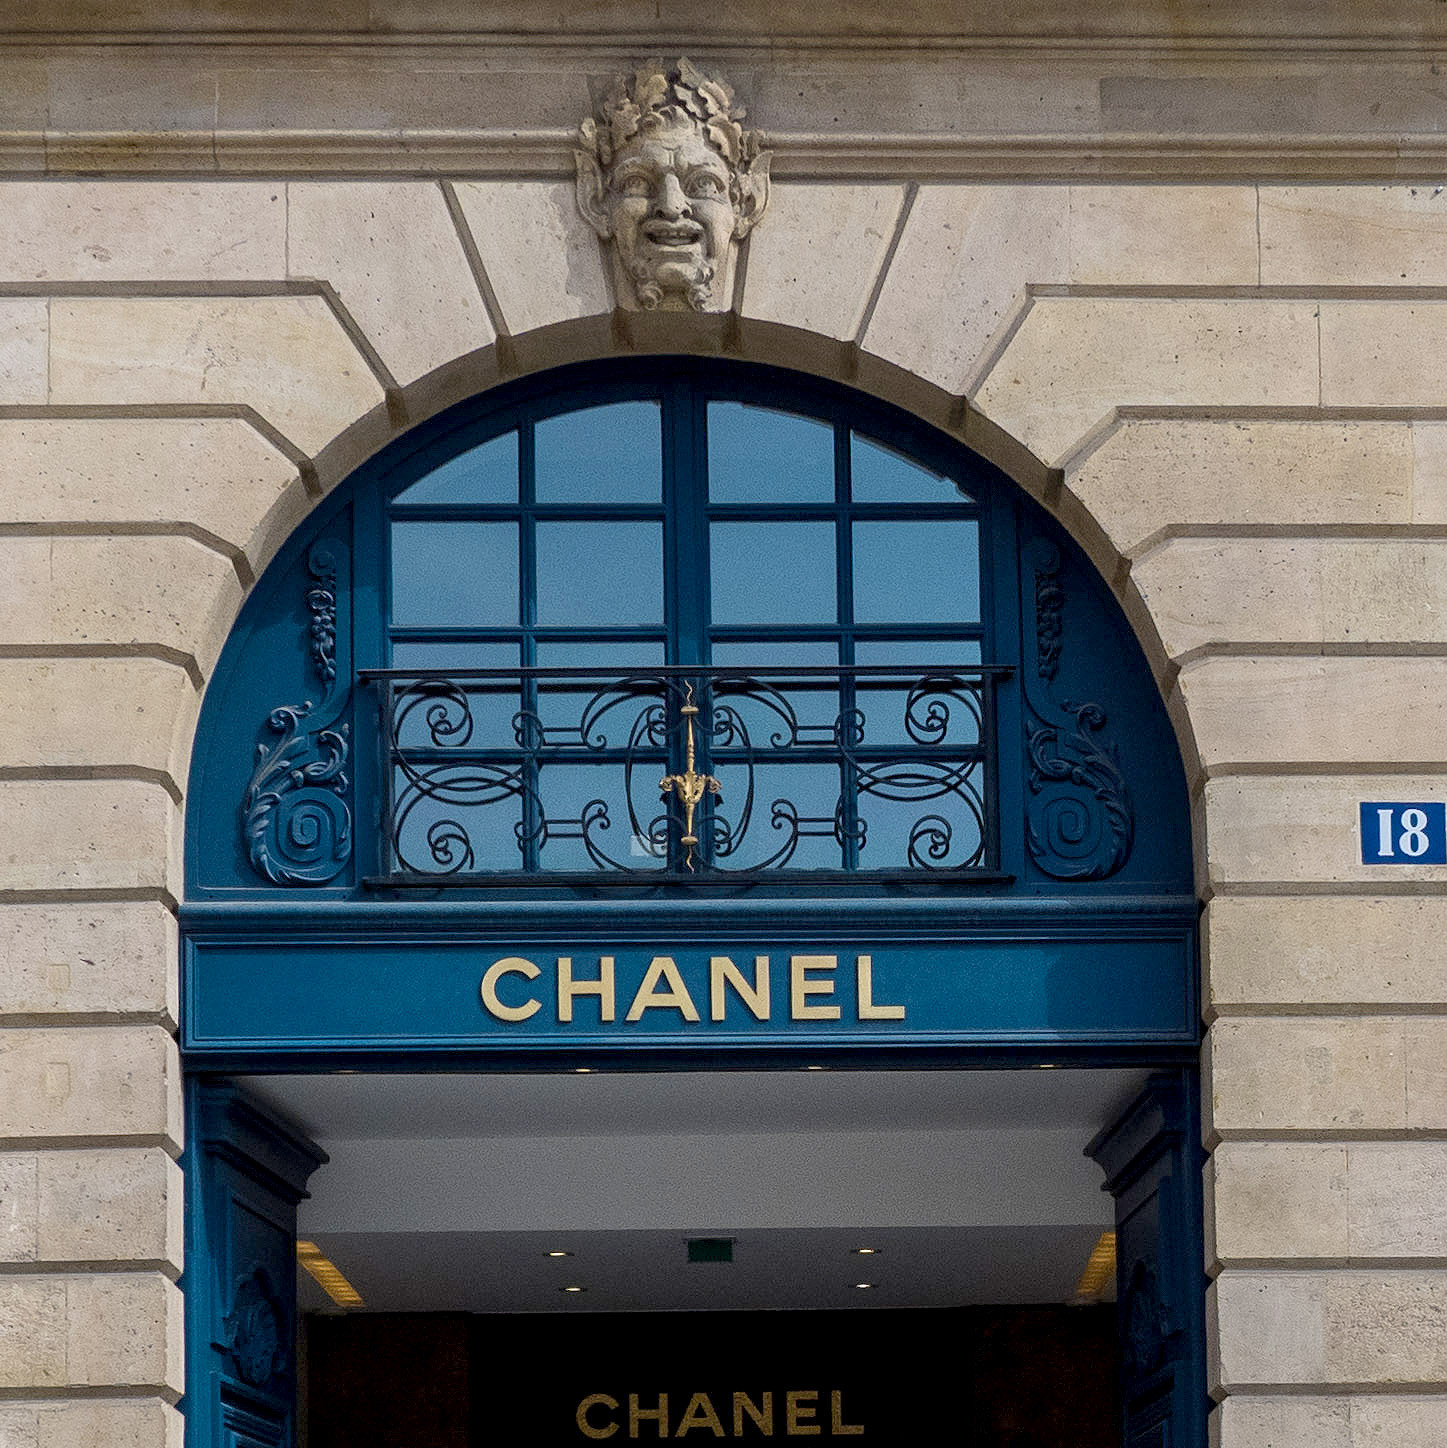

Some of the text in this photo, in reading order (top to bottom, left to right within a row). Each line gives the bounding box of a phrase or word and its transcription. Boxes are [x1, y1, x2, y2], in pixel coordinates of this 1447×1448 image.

[1377, 808, 1430, 857] 18
[481, 955, 906, 1022] CHANEL
[575, 1390, 865, 1439] CHANEL
